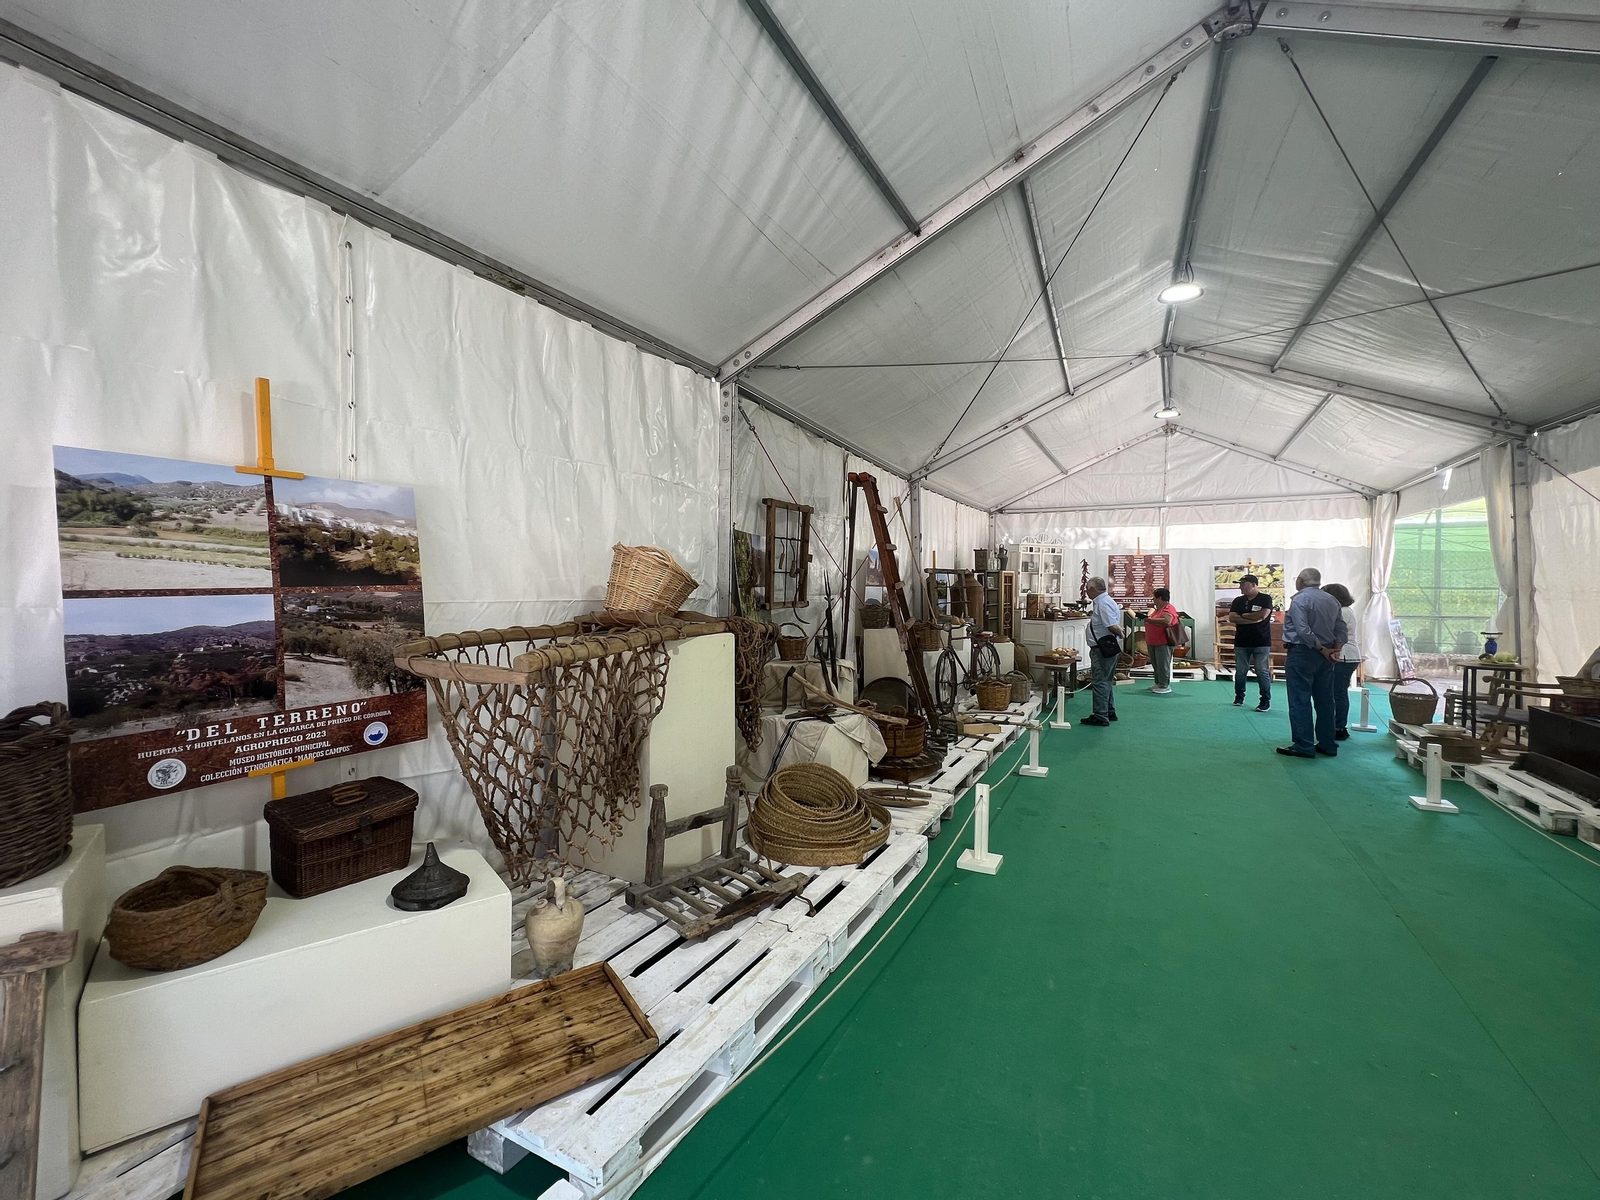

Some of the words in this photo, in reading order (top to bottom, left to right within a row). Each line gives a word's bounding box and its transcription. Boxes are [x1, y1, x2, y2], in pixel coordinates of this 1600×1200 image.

[176, 722, 238, 742] "DEL
[256, 702, 367, 729] TERRENO"
[138, 746, 184, 760] HUERTAS
[194, 734, 252, 750] HORTELANOS
[279, 723, 315, 734] COMARCA
[327, 716, 352, 726] PRIEGO
[363, 710, 392, 719] CÓRDOBA
[234, 734, 303, 754] AGROPRIEGO
[306, 730, 326, 740] 2023
[229, 755, 255, 766] MUSEO
[257, 748, 293, 760] HISTÓRICO
[294, 741, 331, 753] MUNICIPAL
[200, 766, 242, 782] COLECCIÓN
[244, 757, 293, 772] ETNOGRÁFICA
